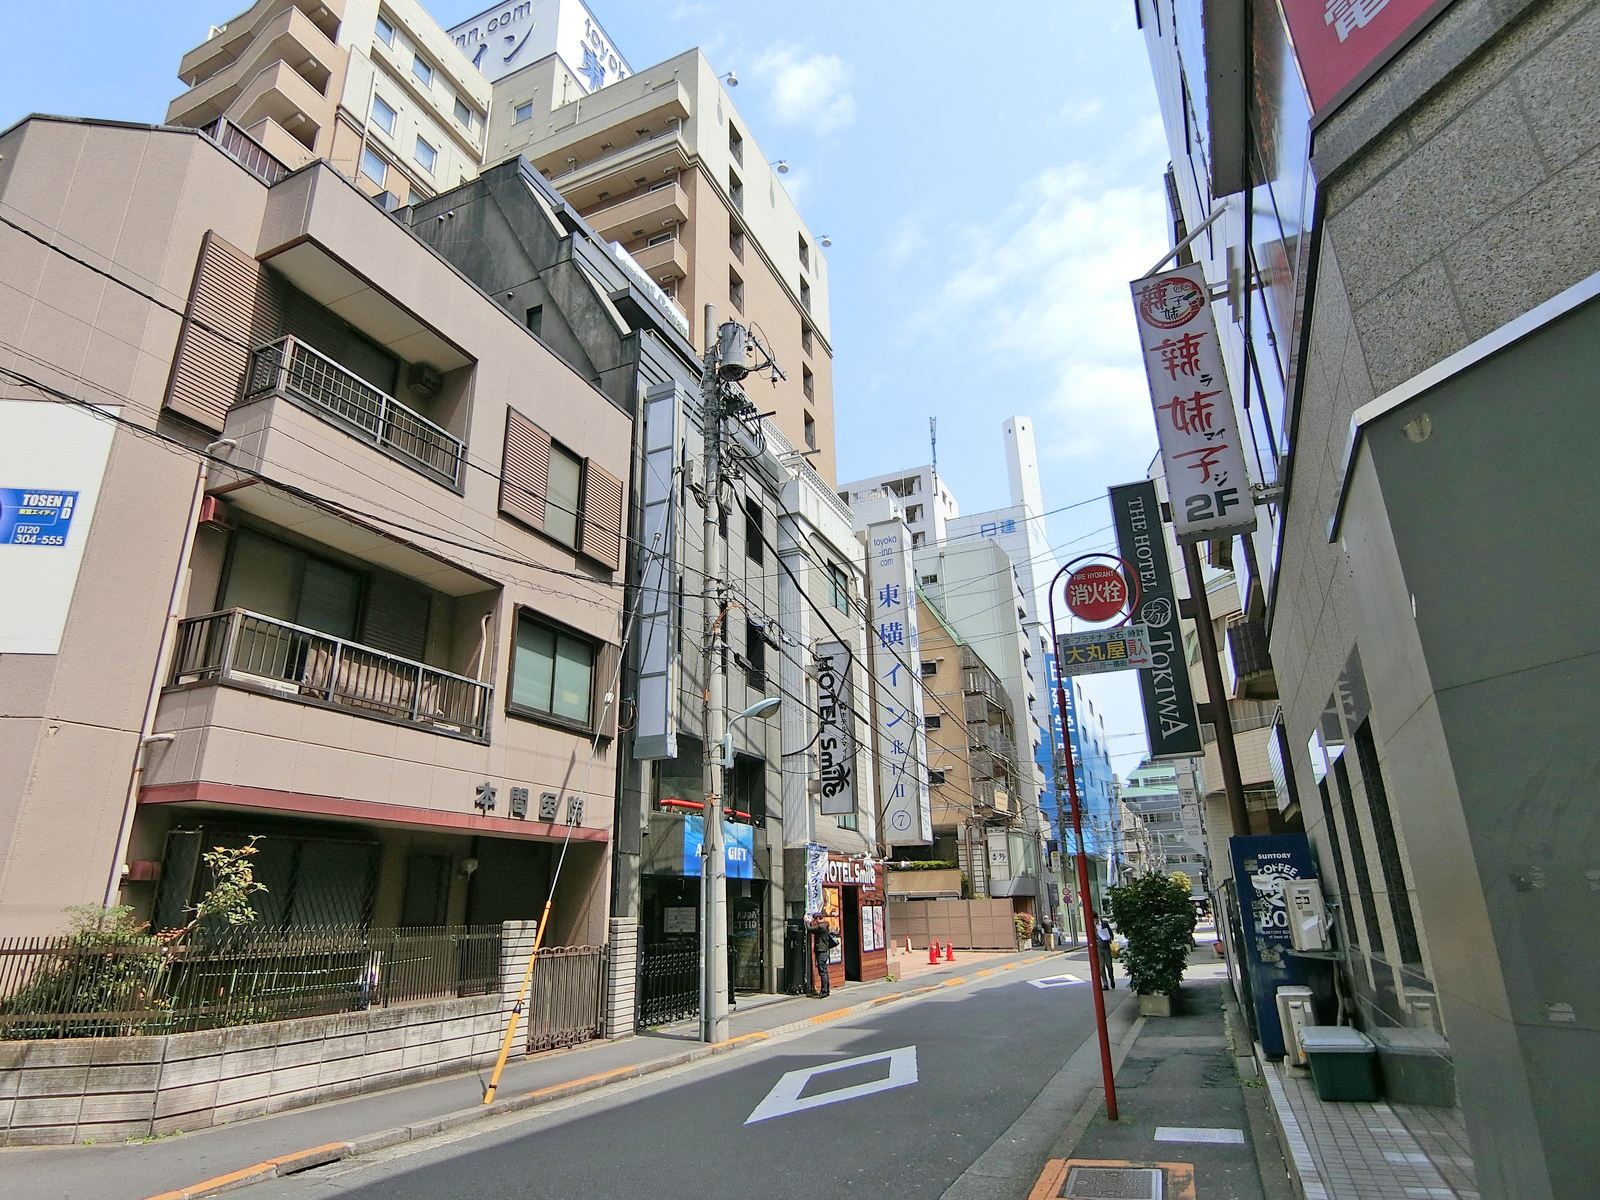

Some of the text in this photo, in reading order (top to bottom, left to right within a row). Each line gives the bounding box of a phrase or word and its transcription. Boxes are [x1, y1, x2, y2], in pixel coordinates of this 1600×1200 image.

[23, 494, 63, 507] TOSEN
[1185, 487, 1240, 523] 2F
[17, 525, 40, 534] 0120
[15, 534, 63, 545] 304-555
[873, 535, 897, 547] toyoko
[1128, 496, 1158, 593] THE HOTEL
[1073, 570, 1115, 581] FIRE HYDRANT
[1070, 580, 1123, 607] 消火栓
[877, 583, 906, 728] 東横イン
[1066, 640, 1127, 664] 大丸屋
[1149, 631, 1189, 739] TOKIWA
[817, 656, 837, 734] HOTEL
[727, 846, 747, 861] GIFT
[1257, 852, 1291, 860] SUNTORY
[1257, 863, 1299, 876] COFFEE
